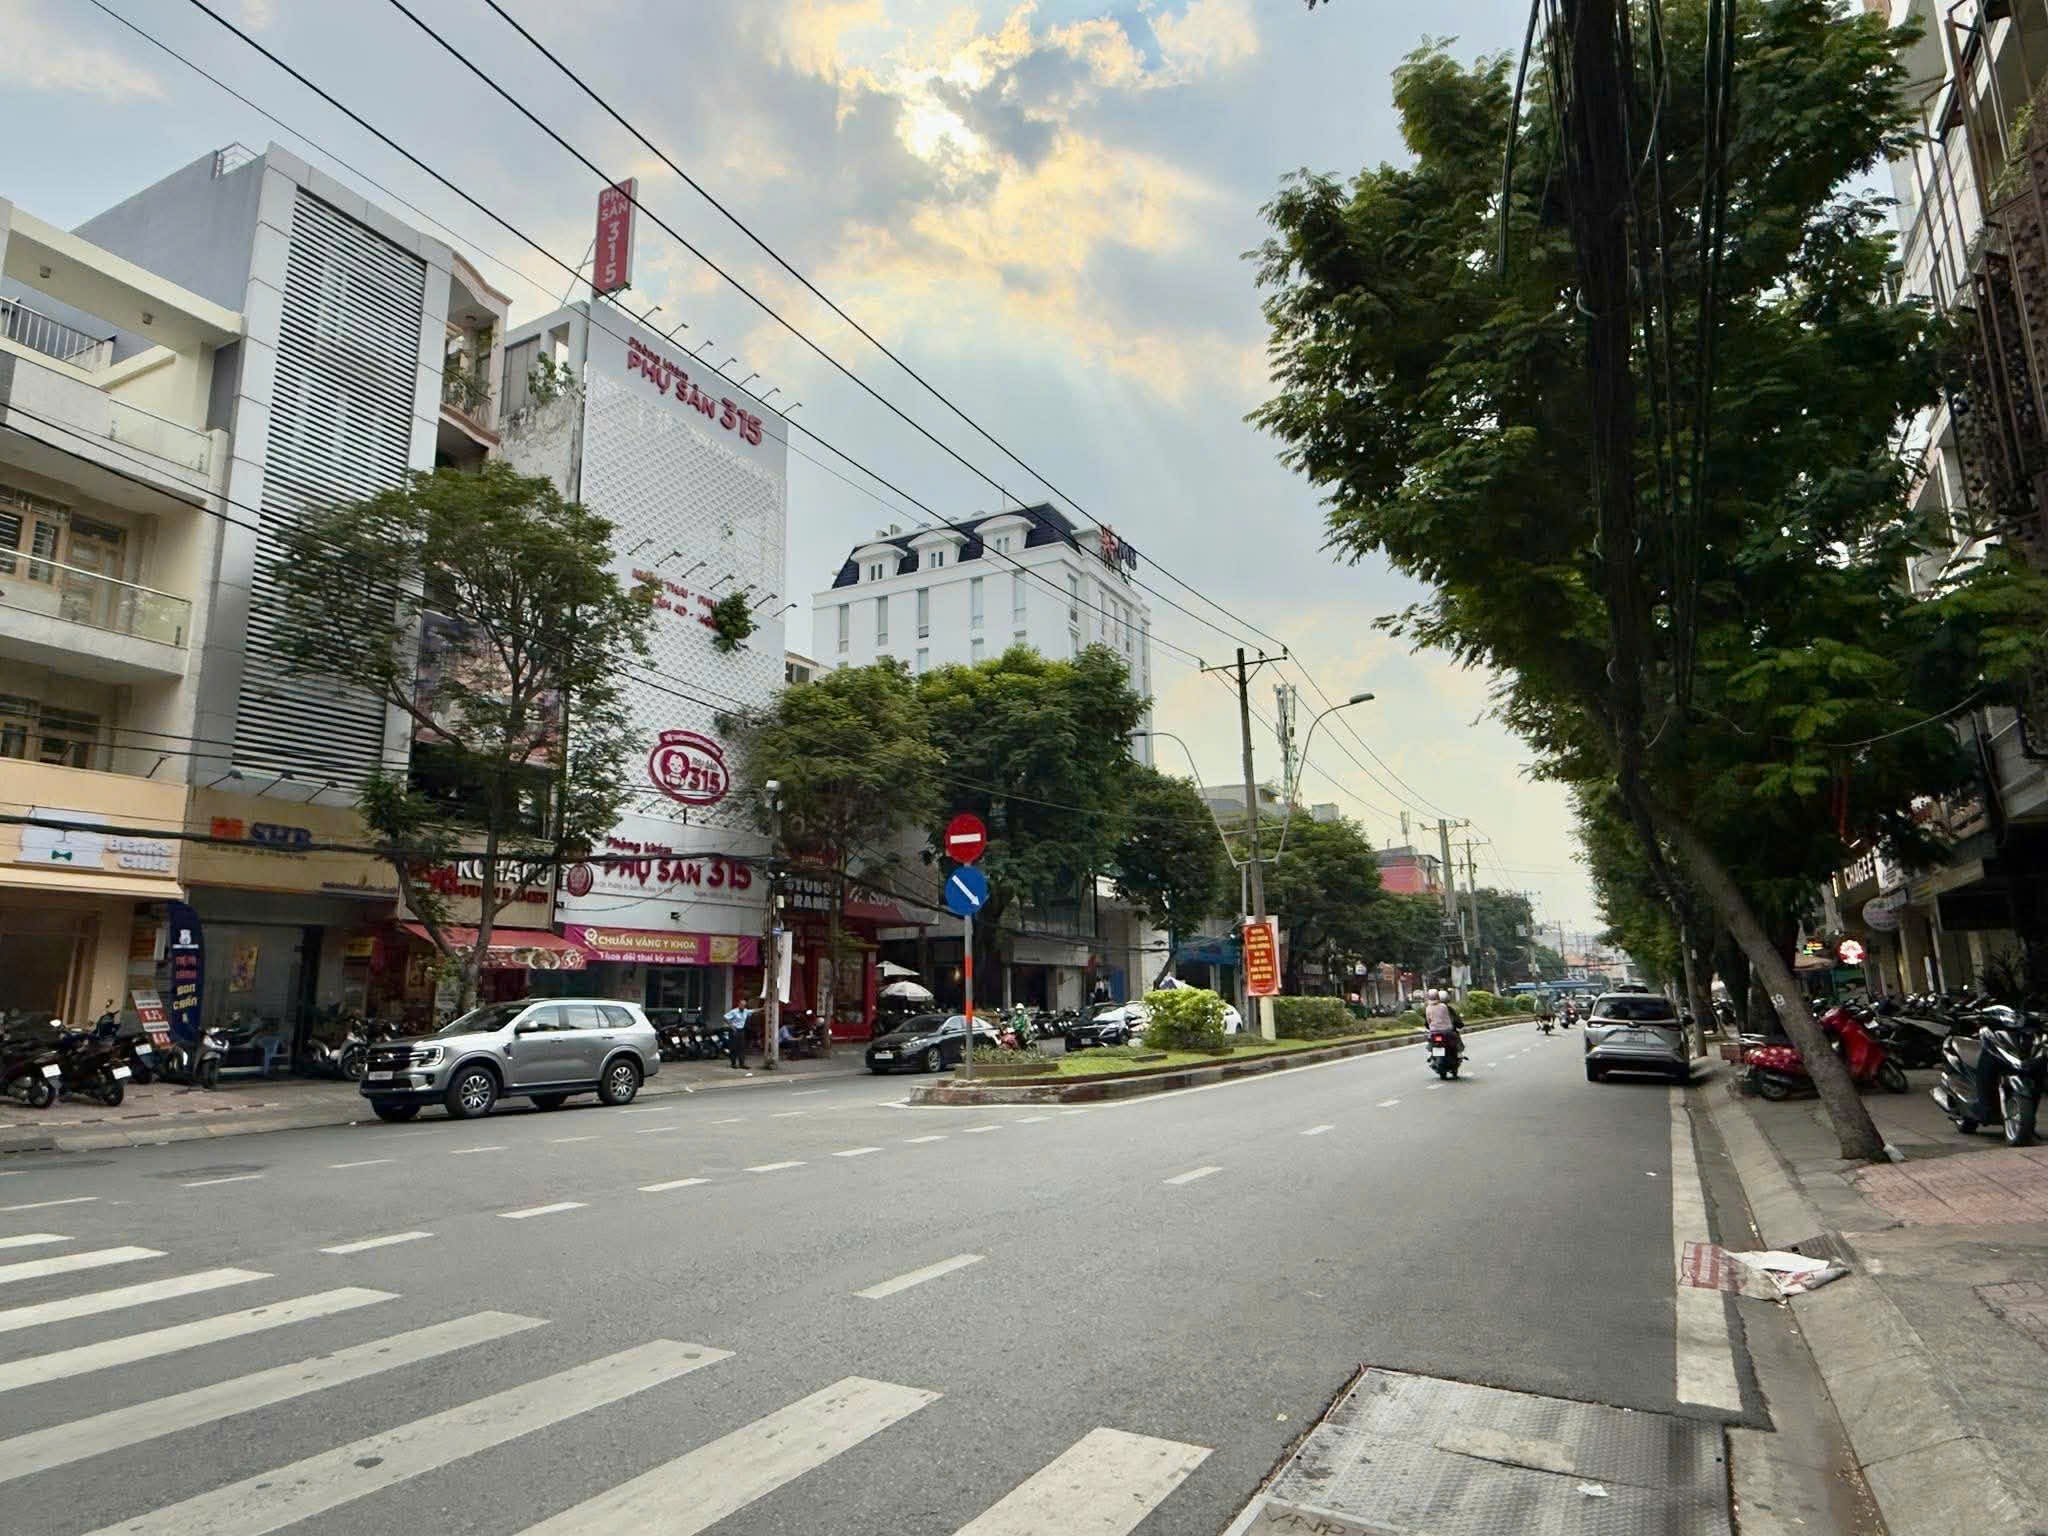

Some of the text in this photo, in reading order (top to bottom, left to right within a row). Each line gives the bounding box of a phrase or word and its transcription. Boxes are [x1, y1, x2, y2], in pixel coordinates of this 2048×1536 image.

[604, 222, 620, 283] 315
[627, 350, 763, 446] PHỤ SẢN 315
[687, 767, 721, 794] 315
[706, 856, 752, 891] 315
